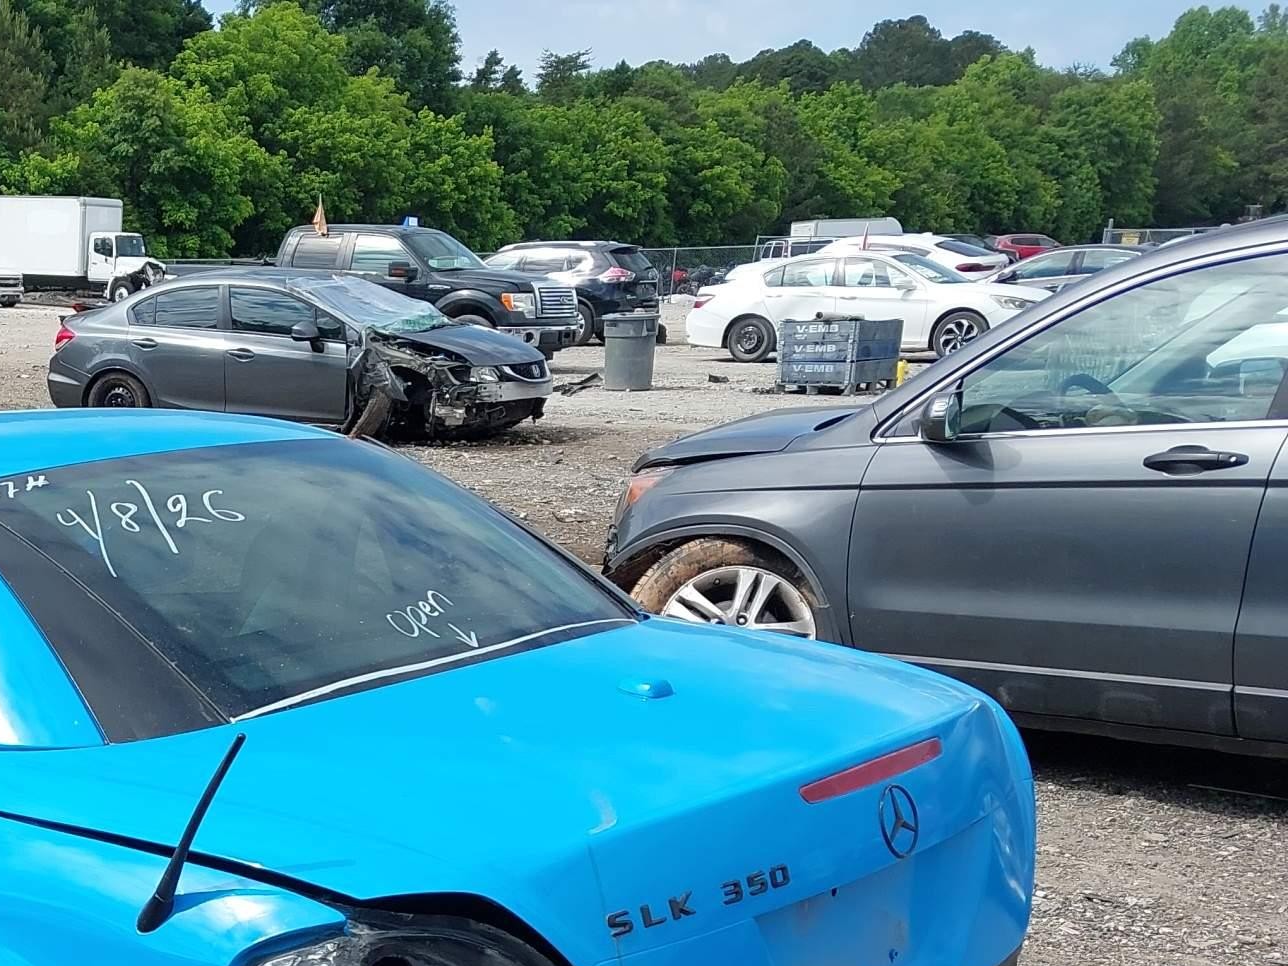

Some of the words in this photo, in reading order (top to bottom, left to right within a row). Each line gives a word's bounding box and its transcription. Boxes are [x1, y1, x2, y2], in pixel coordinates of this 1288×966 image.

[56, 480, 245, 578] 4/8/26
[607, 890, 696, 937] SLK
[720, 863, 791, 905] 350
